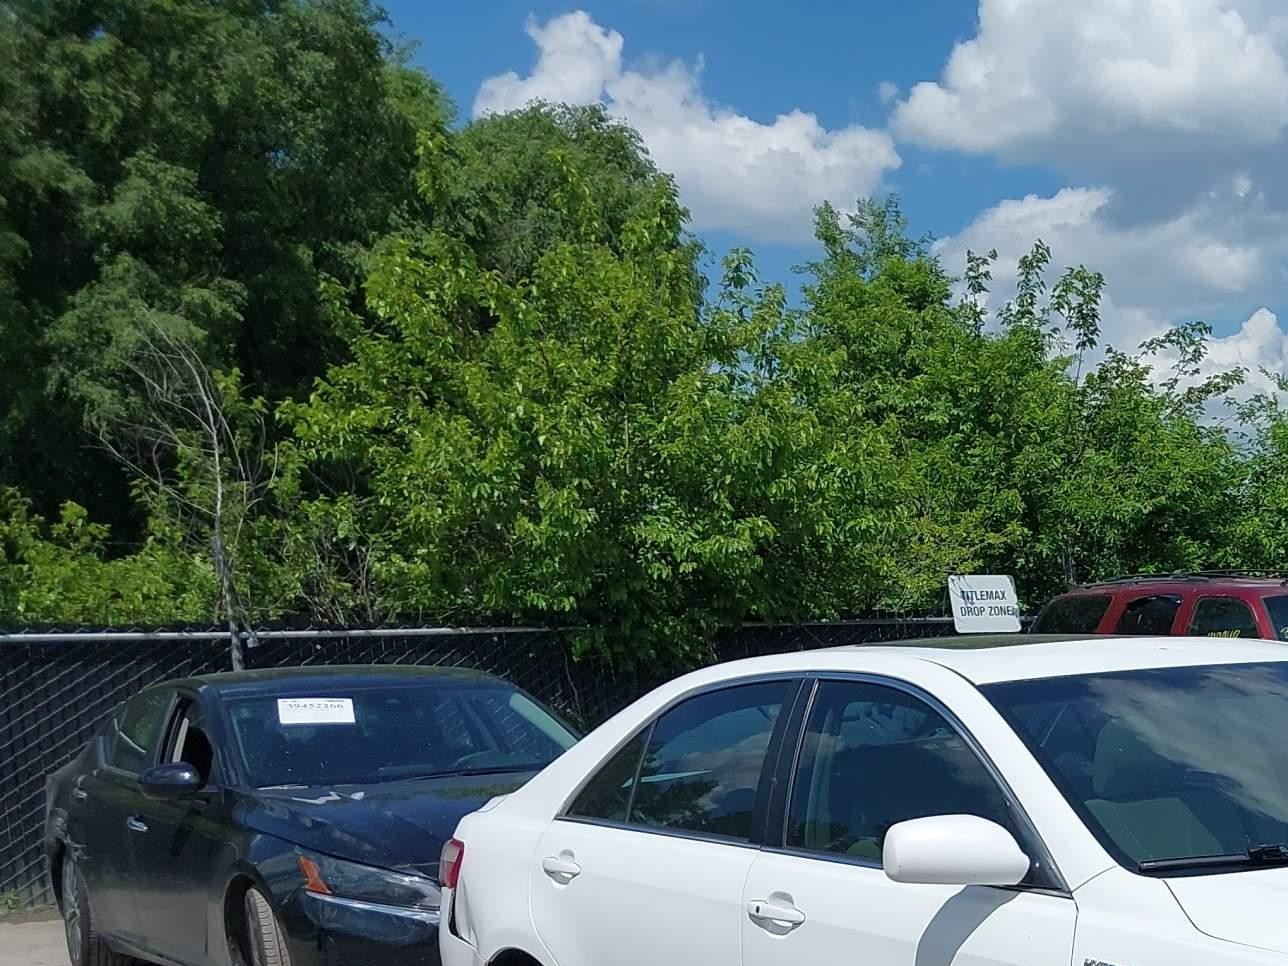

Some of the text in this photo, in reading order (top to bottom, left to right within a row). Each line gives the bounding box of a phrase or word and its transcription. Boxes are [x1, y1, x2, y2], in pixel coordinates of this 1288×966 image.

[960, 590, 1007, 601] TITLEMAX
[960, 605, 1013, 617] DROP ZONE
